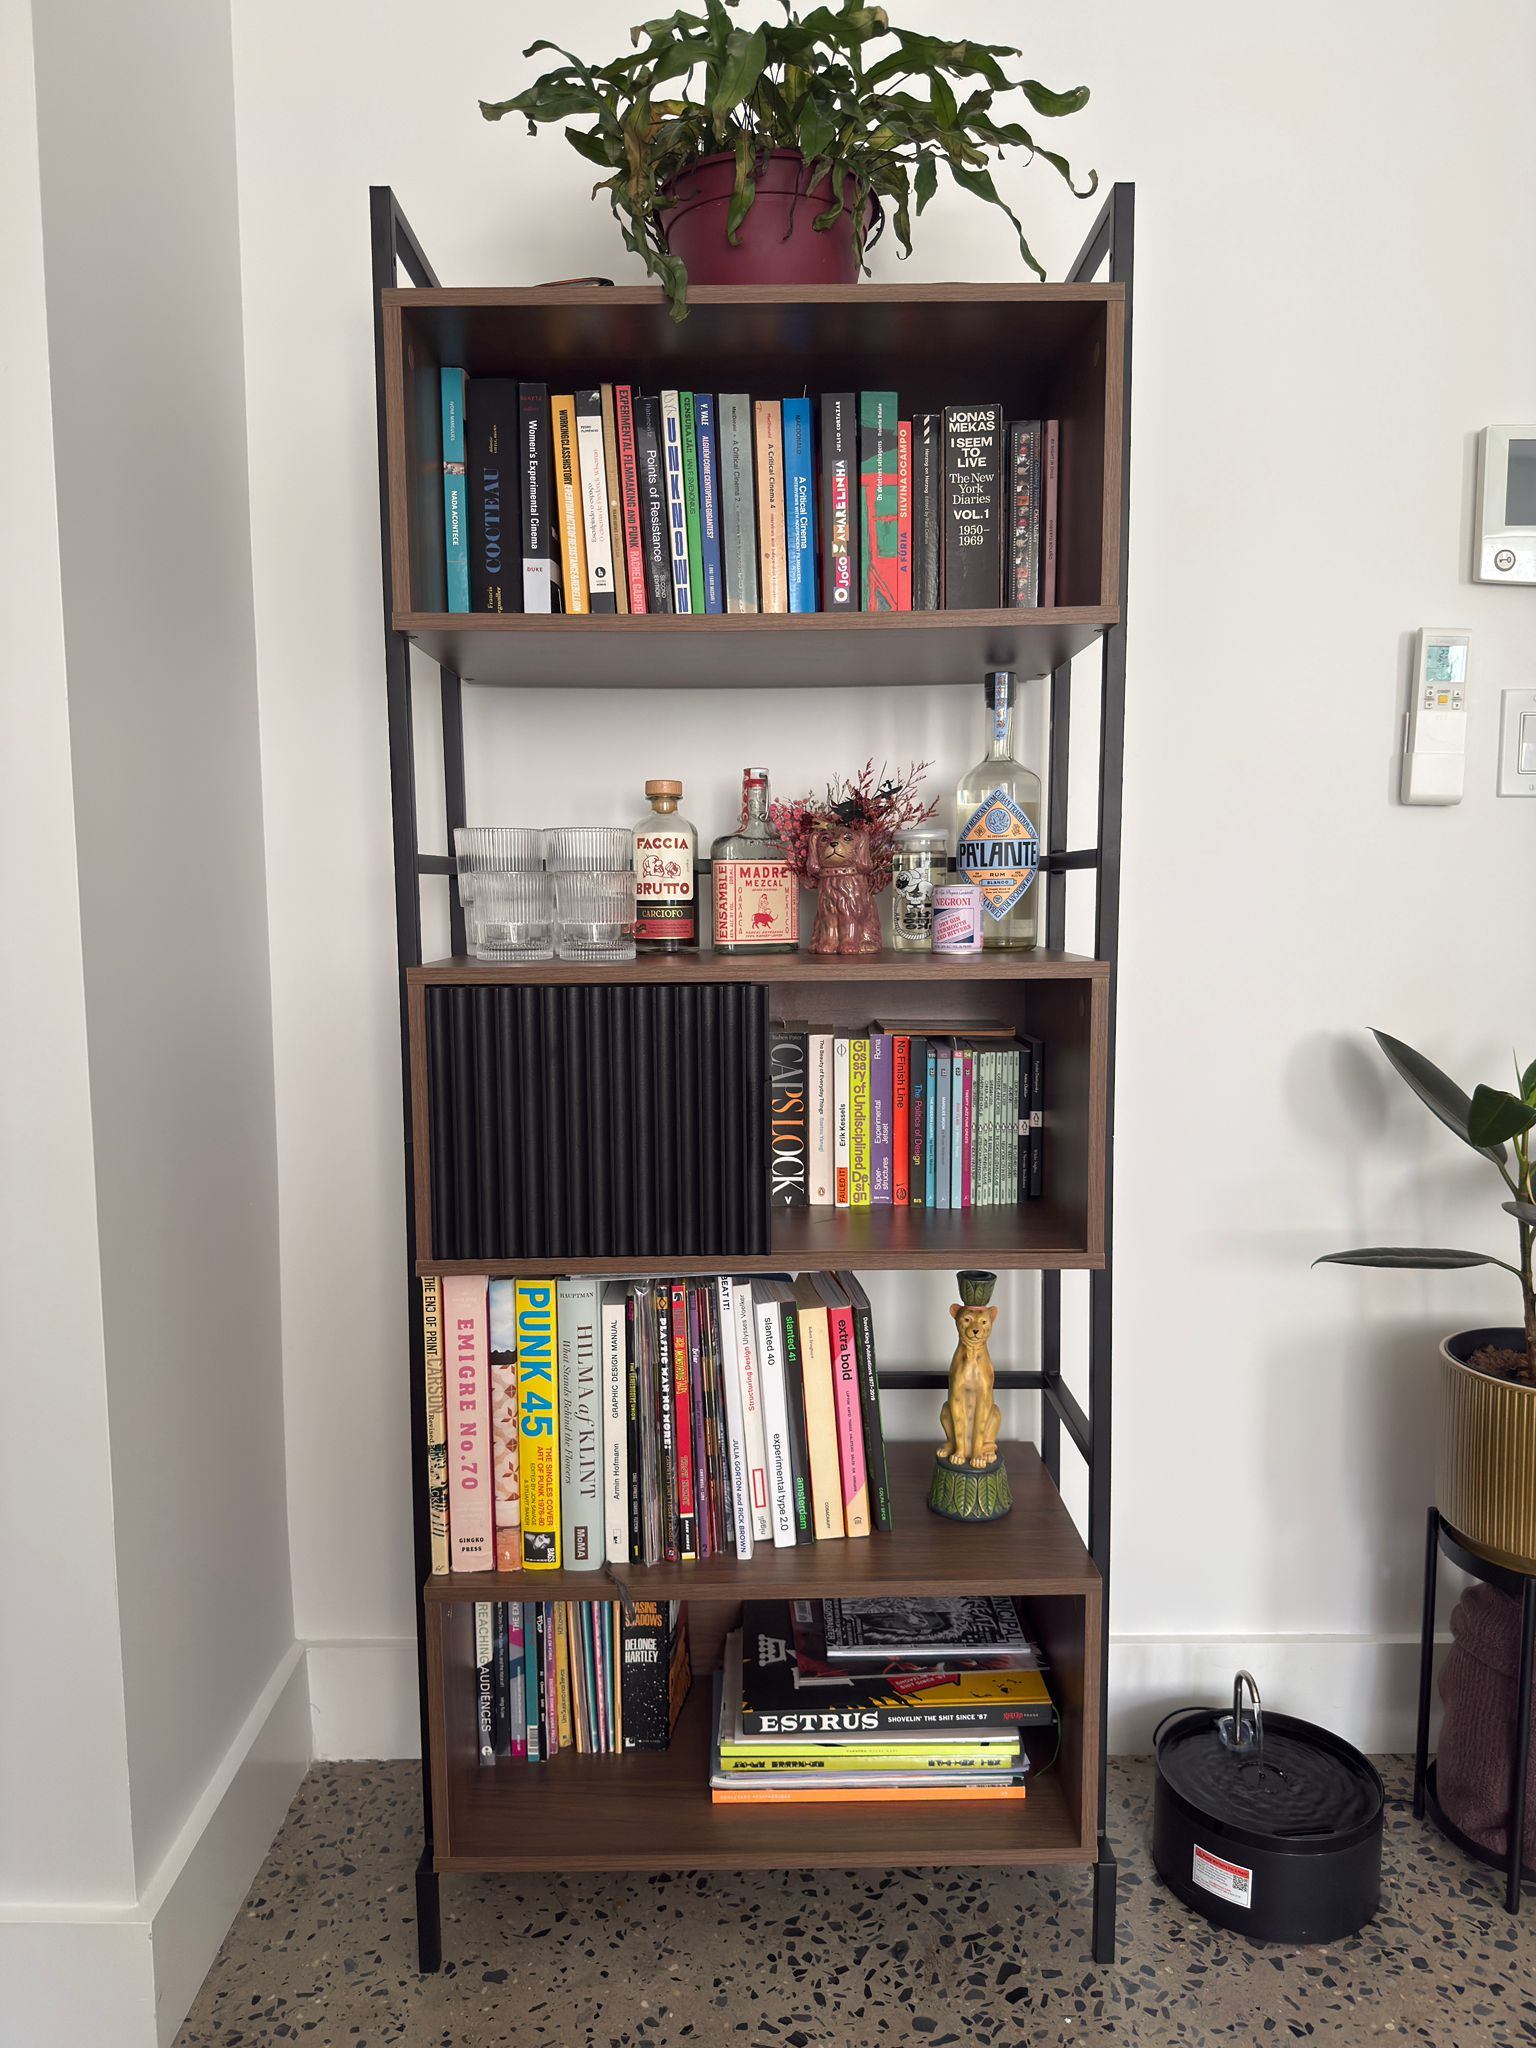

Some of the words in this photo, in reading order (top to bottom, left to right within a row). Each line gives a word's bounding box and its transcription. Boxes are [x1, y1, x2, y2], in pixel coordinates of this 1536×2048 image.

[619, 390, 631, 452] EXPERIMENTAL
[949, 411, 995, 422] JONAS
[949, 422, 995, 432] MEKAS
[899, 429, 907, 476] OCAMPO
[951, 438, 955, 447] I
[956, 437, 992, 447] SEEM
[962, 448, 981, 457] TO
[646, 450, 658, 483] Points
[957, 457, 986, 468] LIVE
[529, 460, 540, 516] Experimental
[623, 454, 636, 508] FILMMAKING
[949, 473, 971, 483] The
[972, 474, 994, 482] New
[959, 484, 983, 494] York
[649, 488, 658, 498] of
[833, 460, 847, 541] AMARELINHA
[899, 478, 907, 518] SILVINA
[952, 494, 991, 504] Diaries
[484, 468, 501, 573] COCTEAU
[628, 510, 636, 523] AND
[666, 417, 689, 613] UNKNOWN
[530, 518, 539, 549] Cinema
[629, 526, 638, 548] PUNK
[650, 502, 662, 562] Resistance
[800, 518, 808, 549] Cinema
[959, 535, 983, 546] 1969
[833, 543, 845, 554] DA
[897, 532, 907, 562] FÚRIA
[630, 551, 641, 581] RACHEL
[838, 557, 849, 586] JOGO
[834, 588, 848, 602] O
[637, 838, 689, 849] FACCIA
[740, 867, 788, 878] MADRE
[637, 883, 689, 894] BRUTTO
[719, 866, 727, 938] ENSAMBLE
[936, 898, 970, 906] NEGRONI
[642, 909, 683, 918] CARCIOFO
[937, 920, 967, 934] VERMOUTH
[948, 925, 971, 938] BITTERS
[898, 1040, 905, 1054] No
[771, 1043, 804, 1113] CAPS
[897, 1057, 906, 1085] Finish
[897, 1087, 906, 1108] Line
[914, 1100, 922, 1127] Politics
[771, 1118, 804, 1195] LOCK
[913, 1139, 922, 1165] Design
[424, 1277, 435, 1292] THE
[425, 1296, 435, 1312] END
[426, 1317, 436, 1328] OF
[518, 1288, 552, 1383] PUNK
[764, 1317, 774, 1351] slanted
[785, 1316, 796, 1350] slanted
[838, 1319, 851, 1351] extra
[426, 1331, 438, 1357] PRINT:
[562, 1340, 571, 1363] What
[660, 1318, 668, 1364] PLASTIC
[457, 1318, 476, 1412] EMIGRE
[576, 1324, 594, 1399] HILMA
[744, 1346, 752, 1370] Design
[767, 1354, 775, 1365] 40
[788, 1352, 796, 1362] 41
[840, 1354, 852, 1381] bold
[427, 1358, 444, 1413] CARSON
[563, 1364, 571, 1397] Stands
[746, 1371, 756, 1411] Structuring
[521, 1391, 553, 1437] 45
[564, 1398, 573, 1431] Behind
[574, 1404, 595, 1427] af
[662, 1394, 670, 1410] NO
[564, 1433, 574, 1447] the
[662, 1414, 671, 1449] MORE!
[460, 1423, 478, 1490] No.70
[733, 1439, 741, 1459] JULIA
[565, 1449, 575, 1484] Flowers
[579, 1430, 596, 1499] KLINT
[734, 1461, 743, 1492] GORTON
[773, 1433, 787, 1493] experimental
[736, 1507, 745, 1524] RICK
[777, 1495, 787, 1515] type
[796, 1477, 807, 1529] amsterdam
[779, 1517, 788, 1531] 2.0
[577, 1529, 585, 1558] MoMA
[738, 1526, 746, 1553] BROWN
[478, 1604, 489, 1663] REACHING
[625, 1638, 657, 1650] DELONGE
[625, 1651, 658, 1662] HARTLEY
[480, 1666, 491, 1732] AUDIENCES
[759, 1711, 879, 1732] ESTRUS
